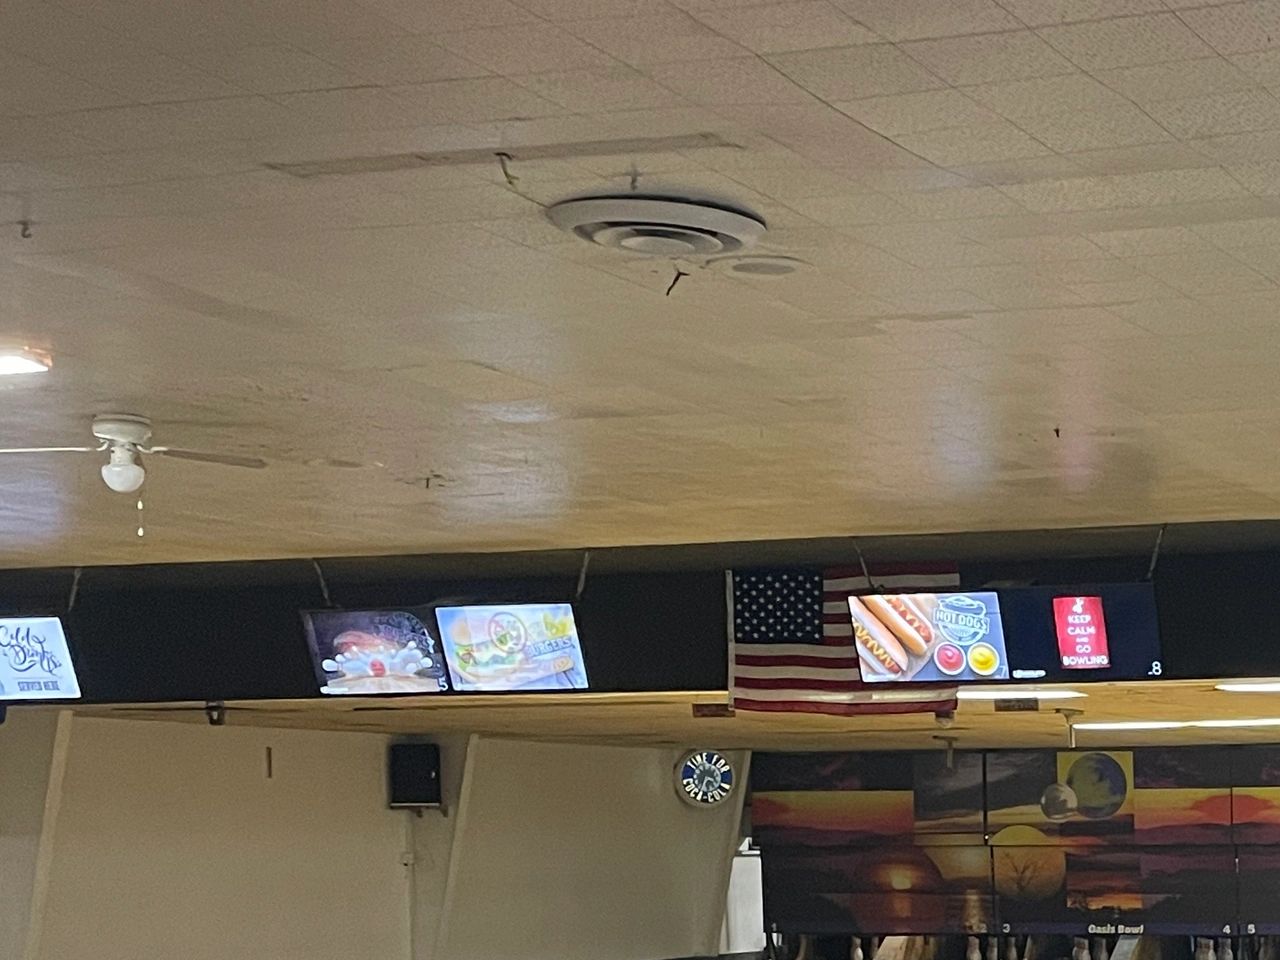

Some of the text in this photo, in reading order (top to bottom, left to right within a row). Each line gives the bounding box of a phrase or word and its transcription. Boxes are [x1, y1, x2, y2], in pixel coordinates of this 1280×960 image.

[937, 609, 987, 631] HOT DOGS
[1067, 615, 1092, 624] KEEP
[1067, 625, 1097, 635] CALM
[1075, 644, 1092, 654] GO
[1062, 655, 1109, 666] BOWLING
[686, 752, 730, 774] TIME FOR
[1002, 923, 1011, 933] 3
[1088, 923, 1144, 934] Oasis Bowl
[1222, 924, 1231, 934] 4
[1247, 923, 1256, 934] 5
